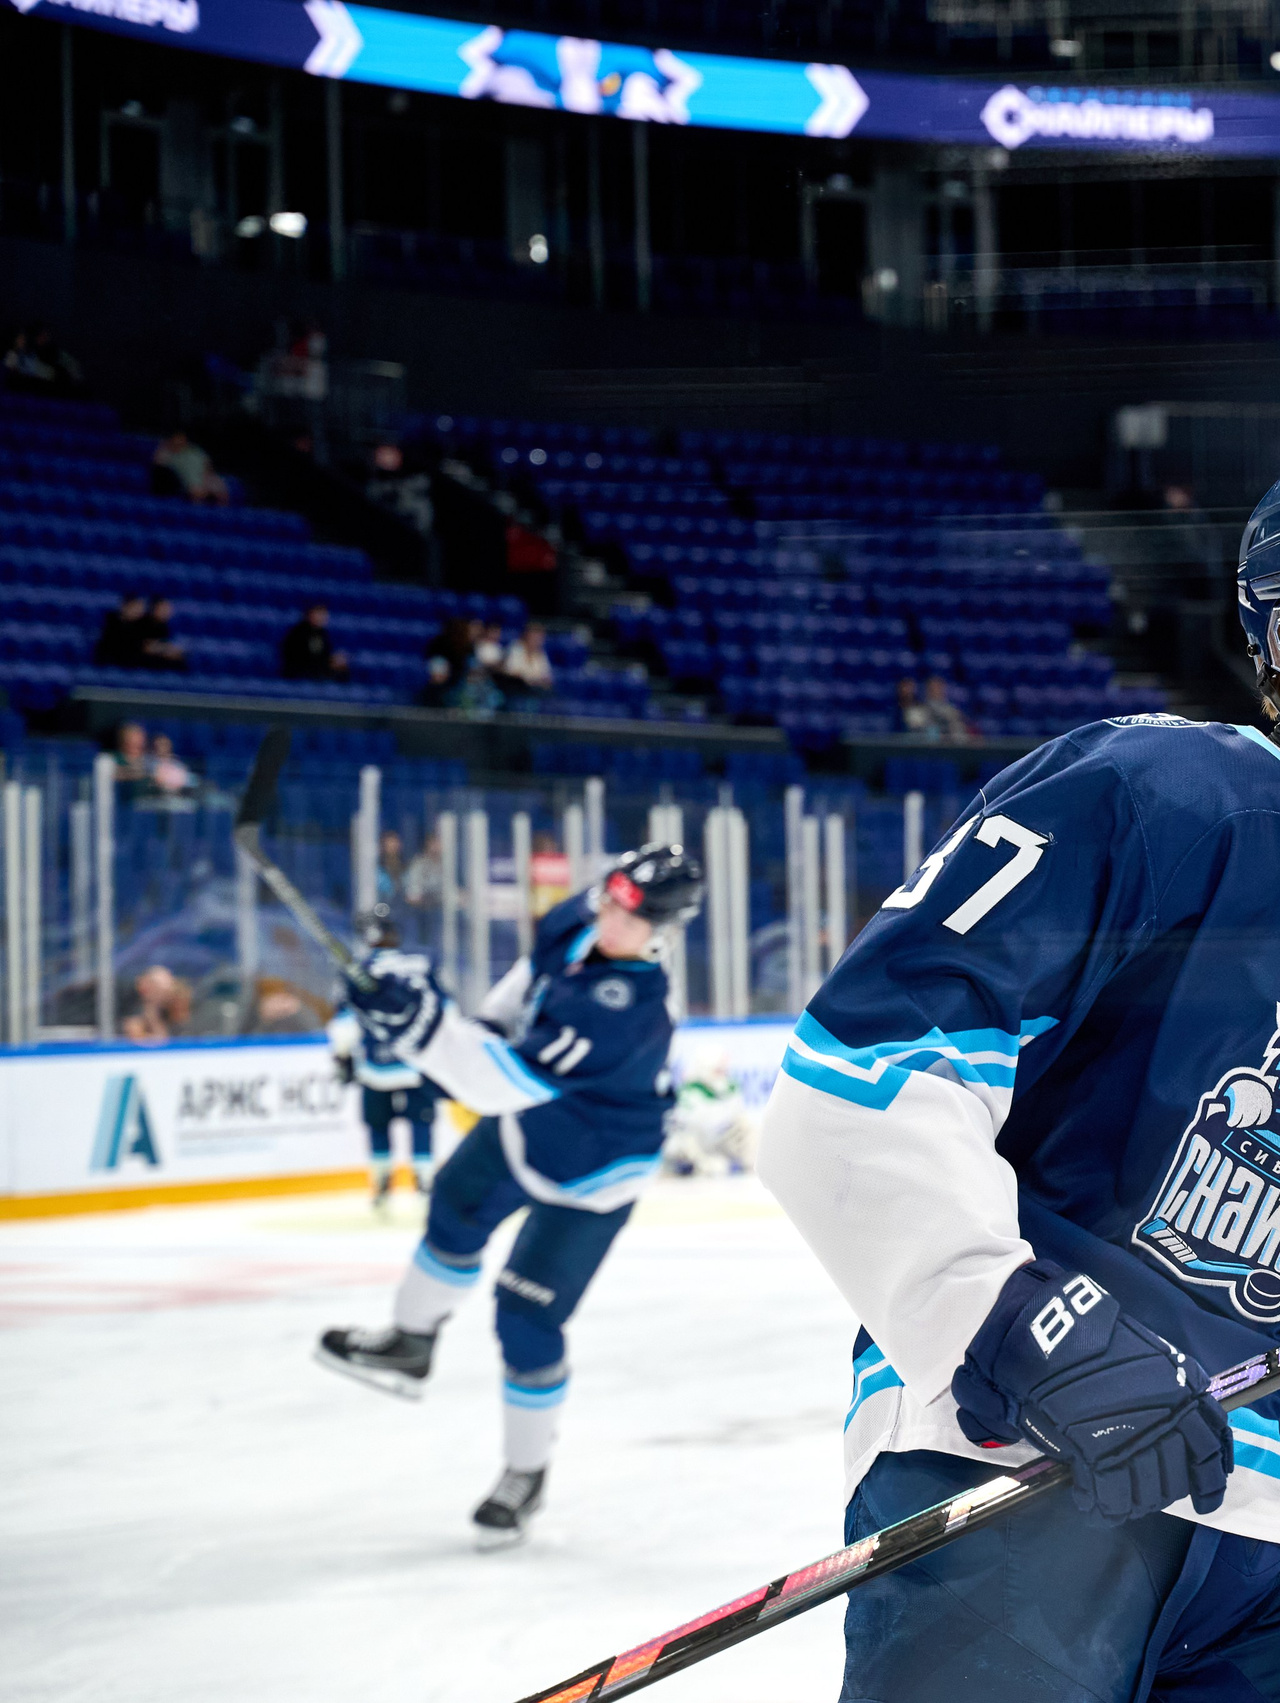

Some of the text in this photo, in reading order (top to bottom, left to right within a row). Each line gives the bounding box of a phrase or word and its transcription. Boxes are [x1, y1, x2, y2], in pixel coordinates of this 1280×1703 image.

[881, 814, 1049, 935] 37
[537, 1024, 593, 1075] 11
[1029, 1273, 1111, 1359] Ba
